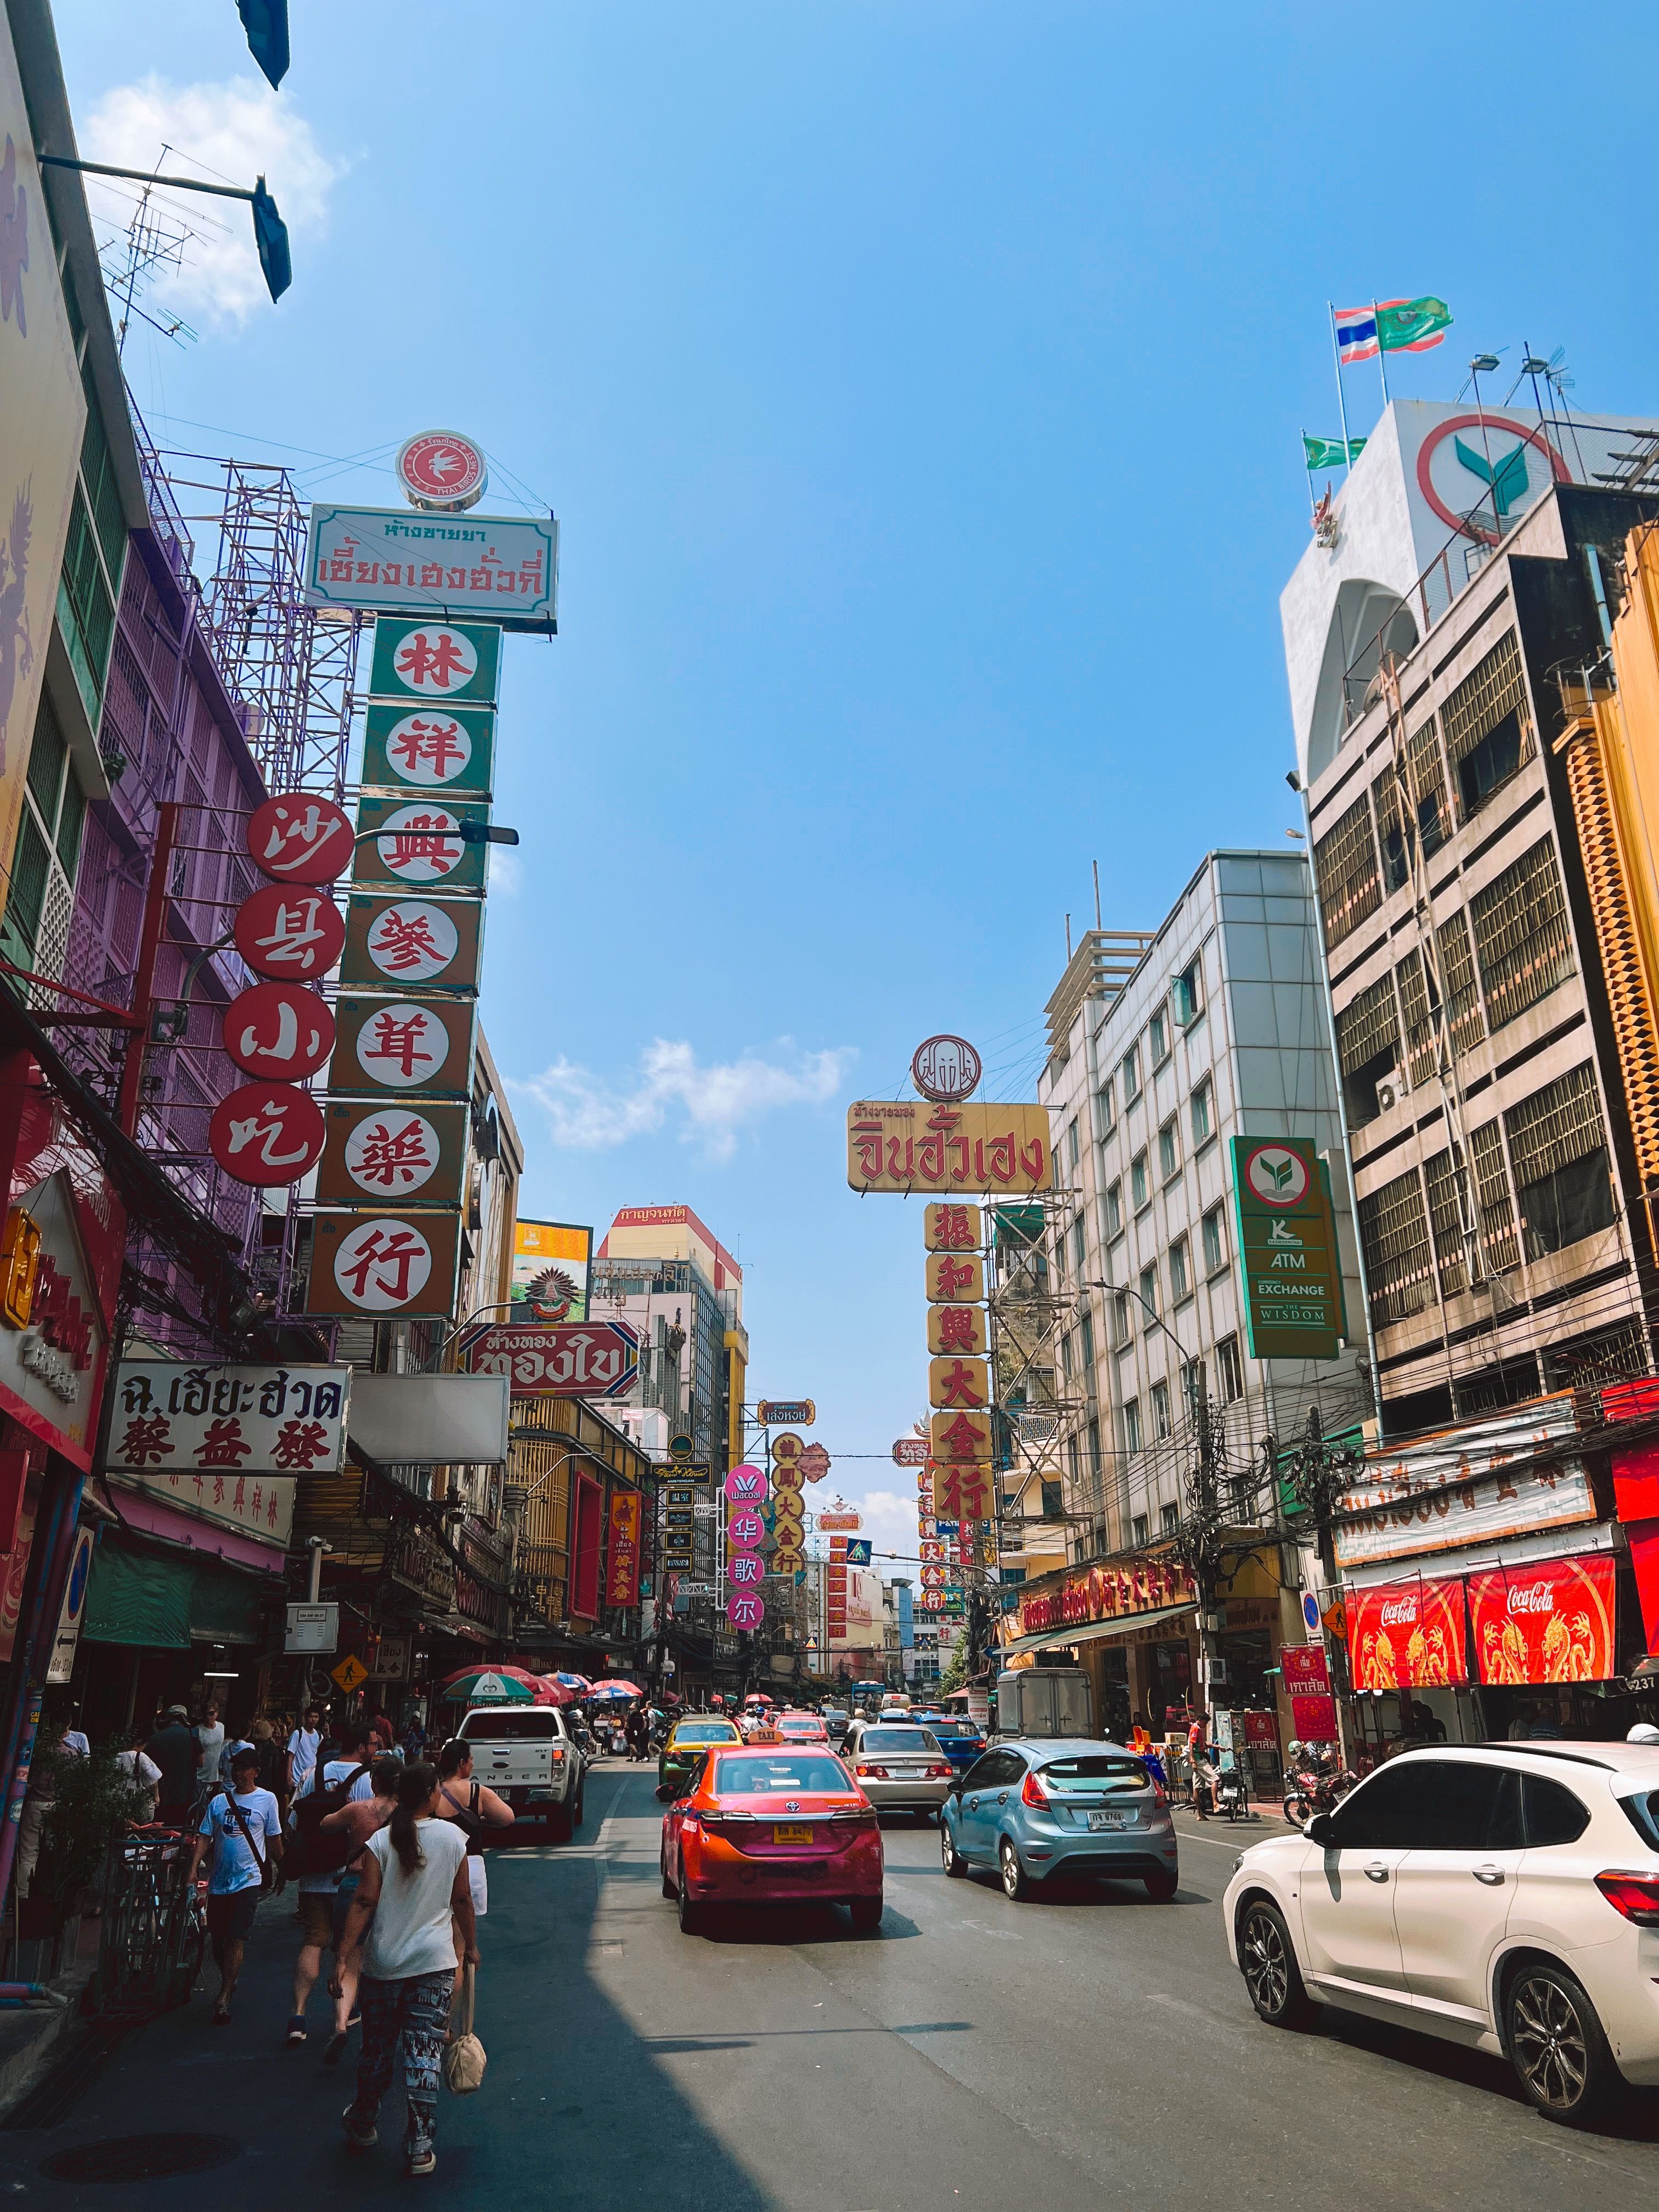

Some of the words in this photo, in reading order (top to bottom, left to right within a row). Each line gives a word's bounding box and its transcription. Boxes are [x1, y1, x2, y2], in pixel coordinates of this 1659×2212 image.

[465, 452, 477, 471] NEST
[458, 471, 476, 490] BIRDS
[436, 486, 458, 495] THAI
[383, 519, 487, 542] ห้างขายยา
[227, 805, 342, 1166] 沙县小吃
[854, 1103, 916, 1118] ห้างขายทอง
[850, 1103, 1044, 1183] จินฮั้วเฮง
[1271, 1253, 1306, 1268] ATM
[1258, 1284, 1325, 1295] EXCHANGE
[1260, 1310, 1324, 1320] WISDOM
[486, 1331, 557, 1350] ห้างทอง
[478, 1333, 622, 1384] ทองใบ
[934, 1204, 988, 1519] 振和興大金行
[767, 1408, 806, 1421] เล่งหงษ์
[115, 1415, 331, 1469] 蔡益發
[731, 1491, 760, 1499] Wacoal
[735, 1519, 757, 1622] 华歌尔
[1507, 1581, 1555, 1615] Coca-Cola
[1381, 1594, 1418, 1627] Coca-Cola
[1290, 1677, 1326, 1692] เกาลัด
[758, 1731, 775, 1740] TAXI
